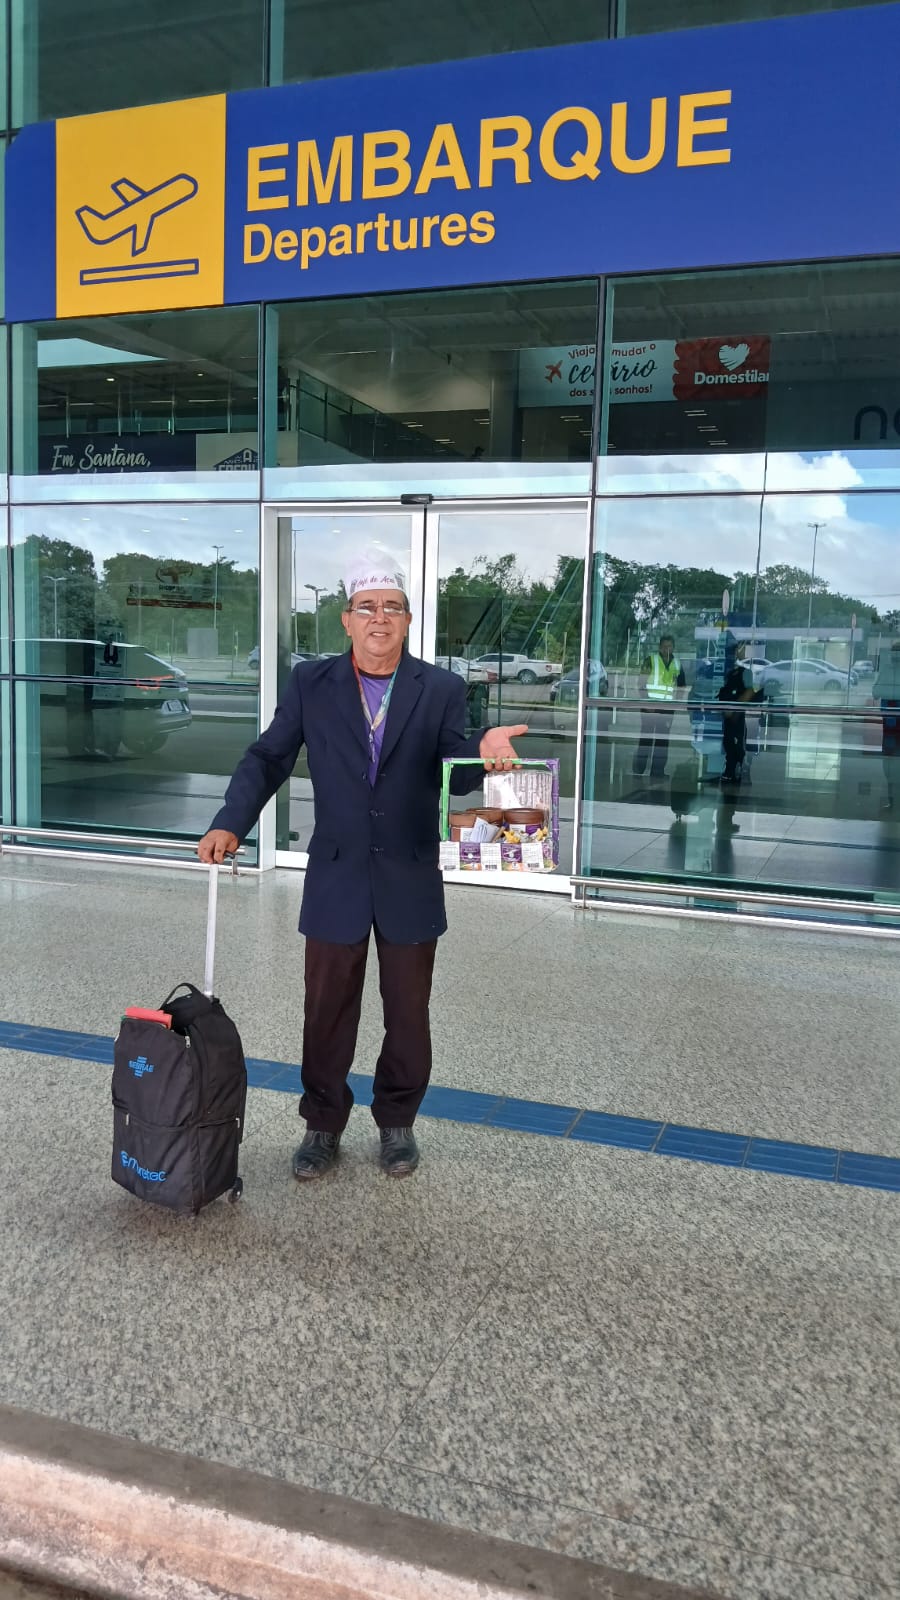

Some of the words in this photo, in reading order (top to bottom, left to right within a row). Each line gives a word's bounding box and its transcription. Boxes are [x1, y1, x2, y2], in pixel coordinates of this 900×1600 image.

[247, 90, 732, 212] EMBARQUE
[243, 210, 496, 270] Departures
[611, 346, 646, 357] mudar
[569, 388, 587, 397] dos
[614, 384, 653, 395] sonhos!
[51, 445, 75, 471] Em
[79, 443, 151, 470] Santana,
